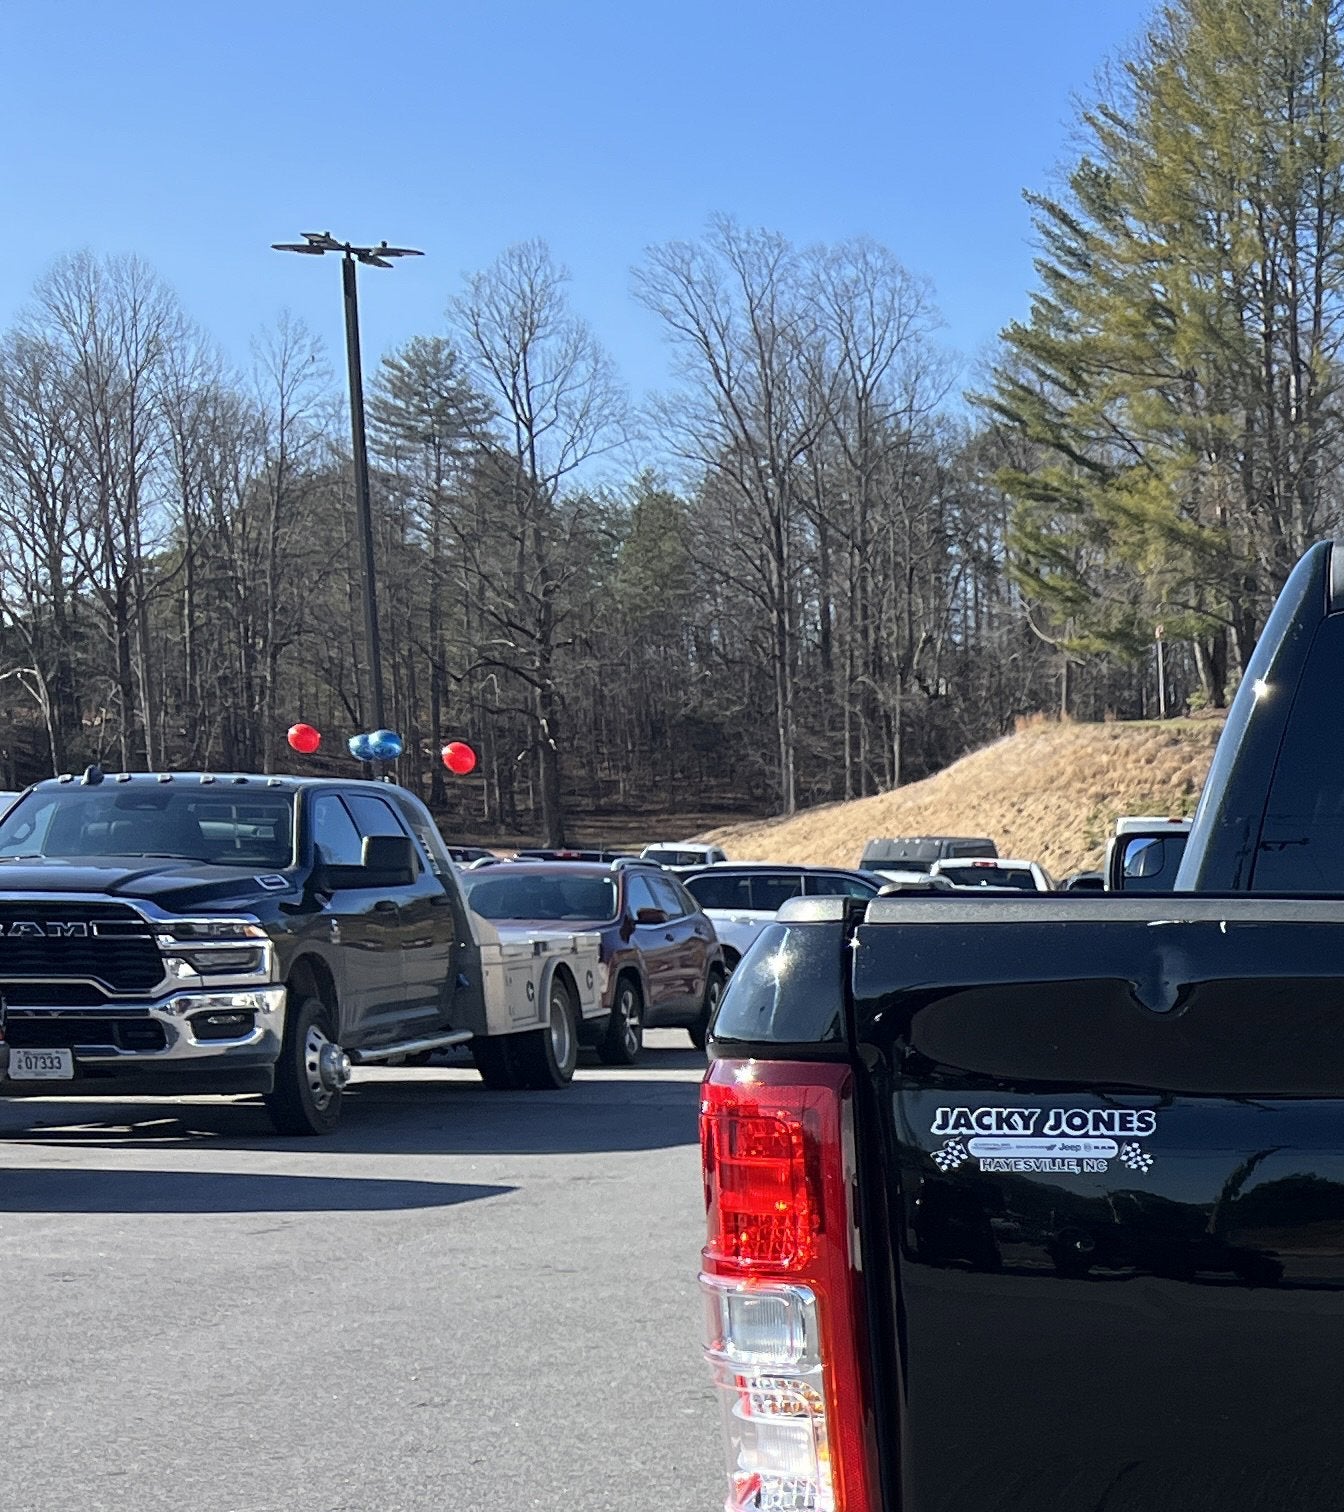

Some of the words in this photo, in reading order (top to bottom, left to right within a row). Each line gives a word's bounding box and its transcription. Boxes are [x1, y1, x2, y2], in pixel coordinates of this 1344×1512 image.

[0, 922, 88, 937] AM
[931, 1108, 1040, 1135] JACKY
[1043, 1109, 1157, 1136] JONES
[1058, 1142, 1082, 1153] Jeep
[980, 1158, 1081, 1174] HAYESVILLE,
[1083, 1159, 1108, 1172] NC
